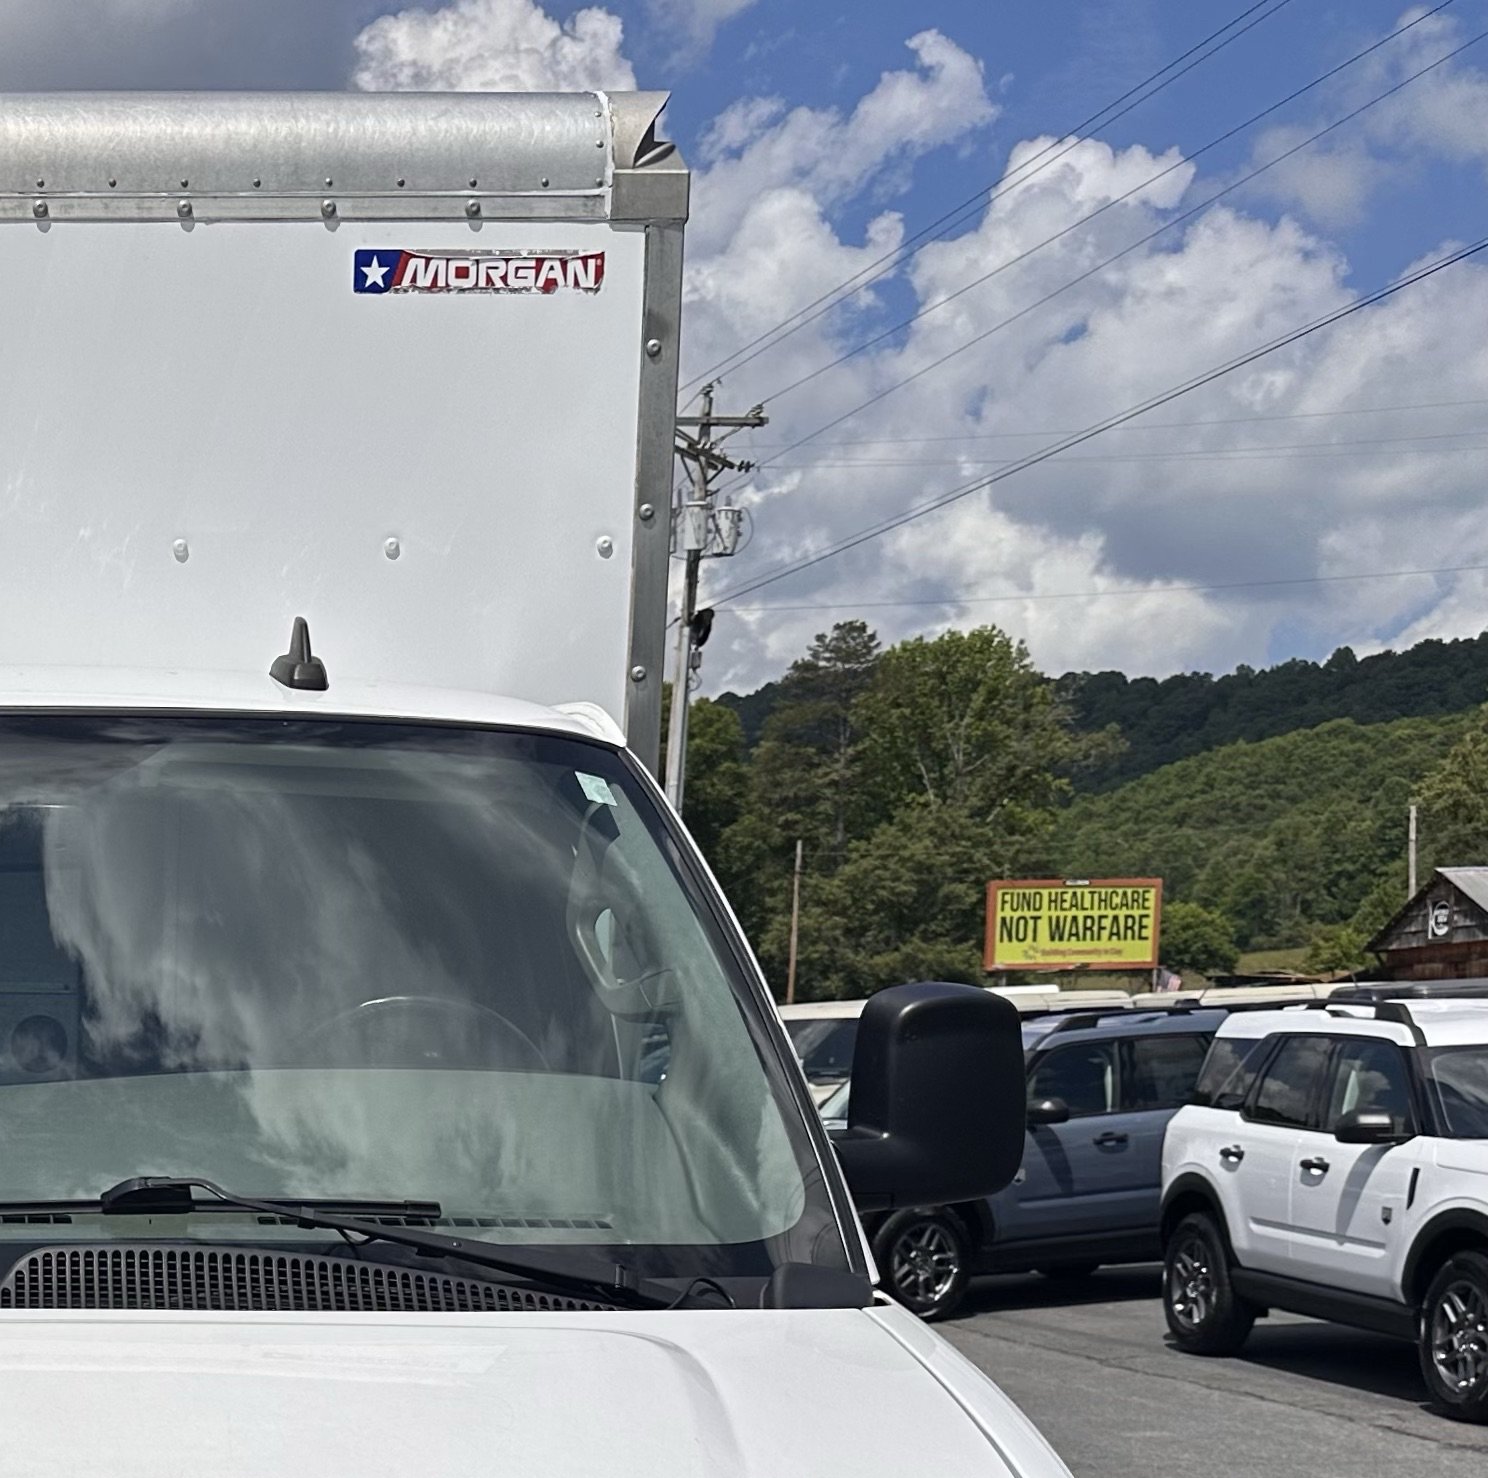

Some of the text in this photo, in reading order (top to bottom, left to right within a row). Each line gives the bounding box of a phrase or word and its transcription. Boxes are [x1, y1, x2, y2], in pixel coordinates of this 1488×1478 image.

[401, 257, 595, 288] MORGAN
[1001, 889, 1151, 912] FUND HEALTHCARE
[999, 914, 1150, 943] NOT WARFARE
